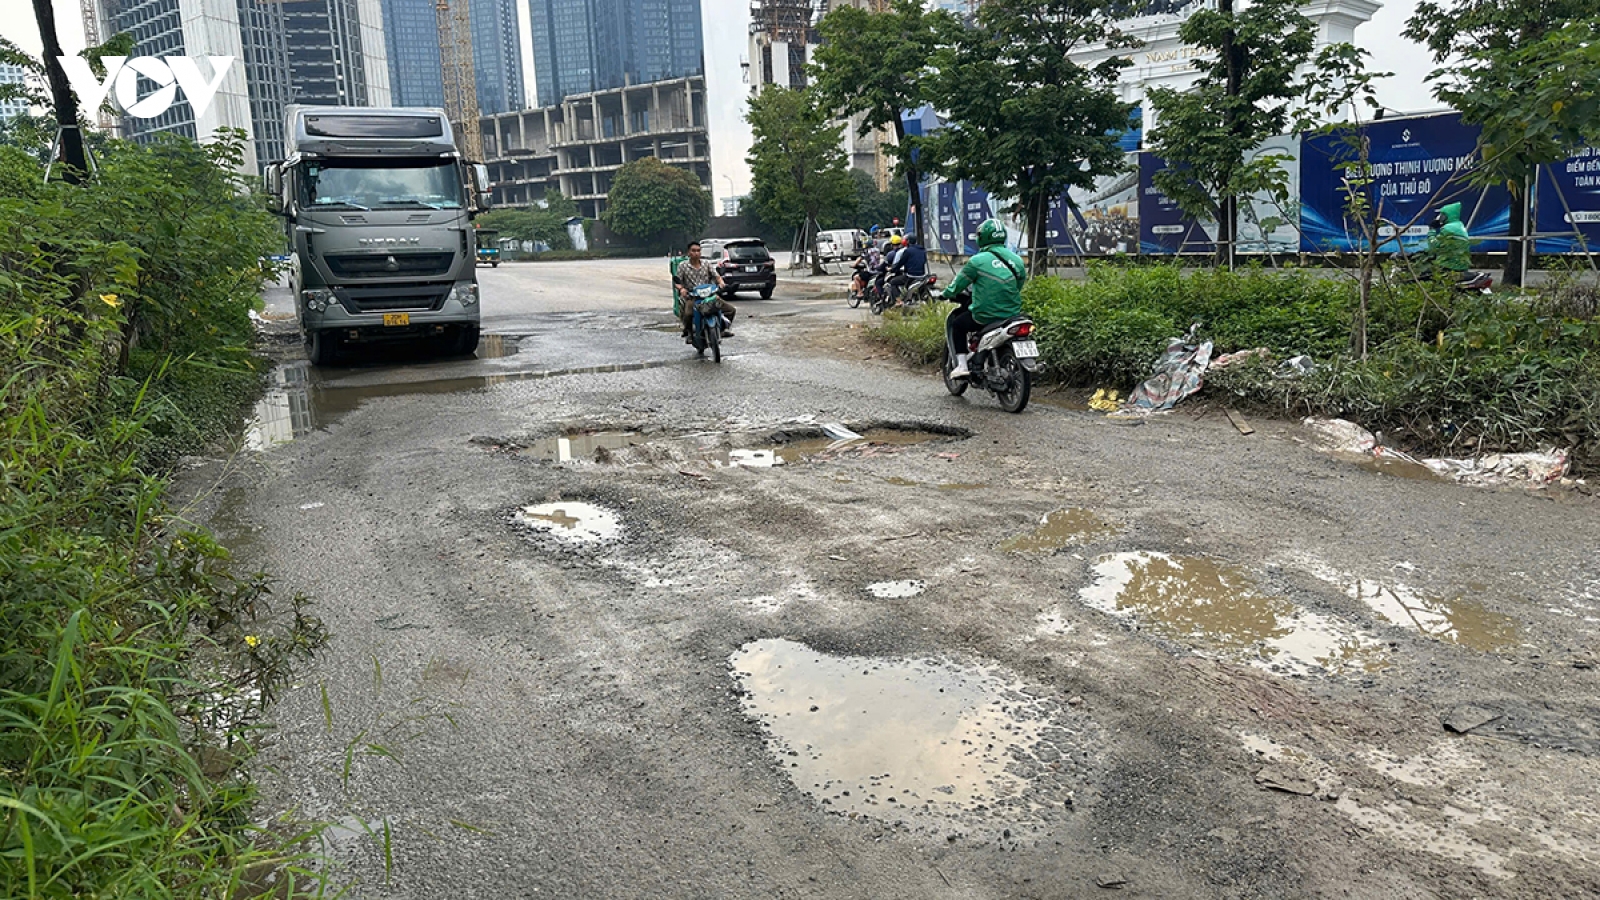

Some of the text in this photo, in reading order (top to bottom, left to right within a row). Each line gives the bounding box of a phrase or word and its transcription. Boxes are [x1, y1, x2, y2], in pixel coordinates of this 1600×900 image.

[1146, 49, 1178, 64] NAM
[1394, 160, 1421, 176] THỊNH
[1422, 157, 1453, 175] VƯỢNG
[1381, 177, 1431, 196] CỦA THỦ ĐÔ
[1575, 175, 1594, 187] TOÀN
[359, 237, 419, 245] SITRAK
